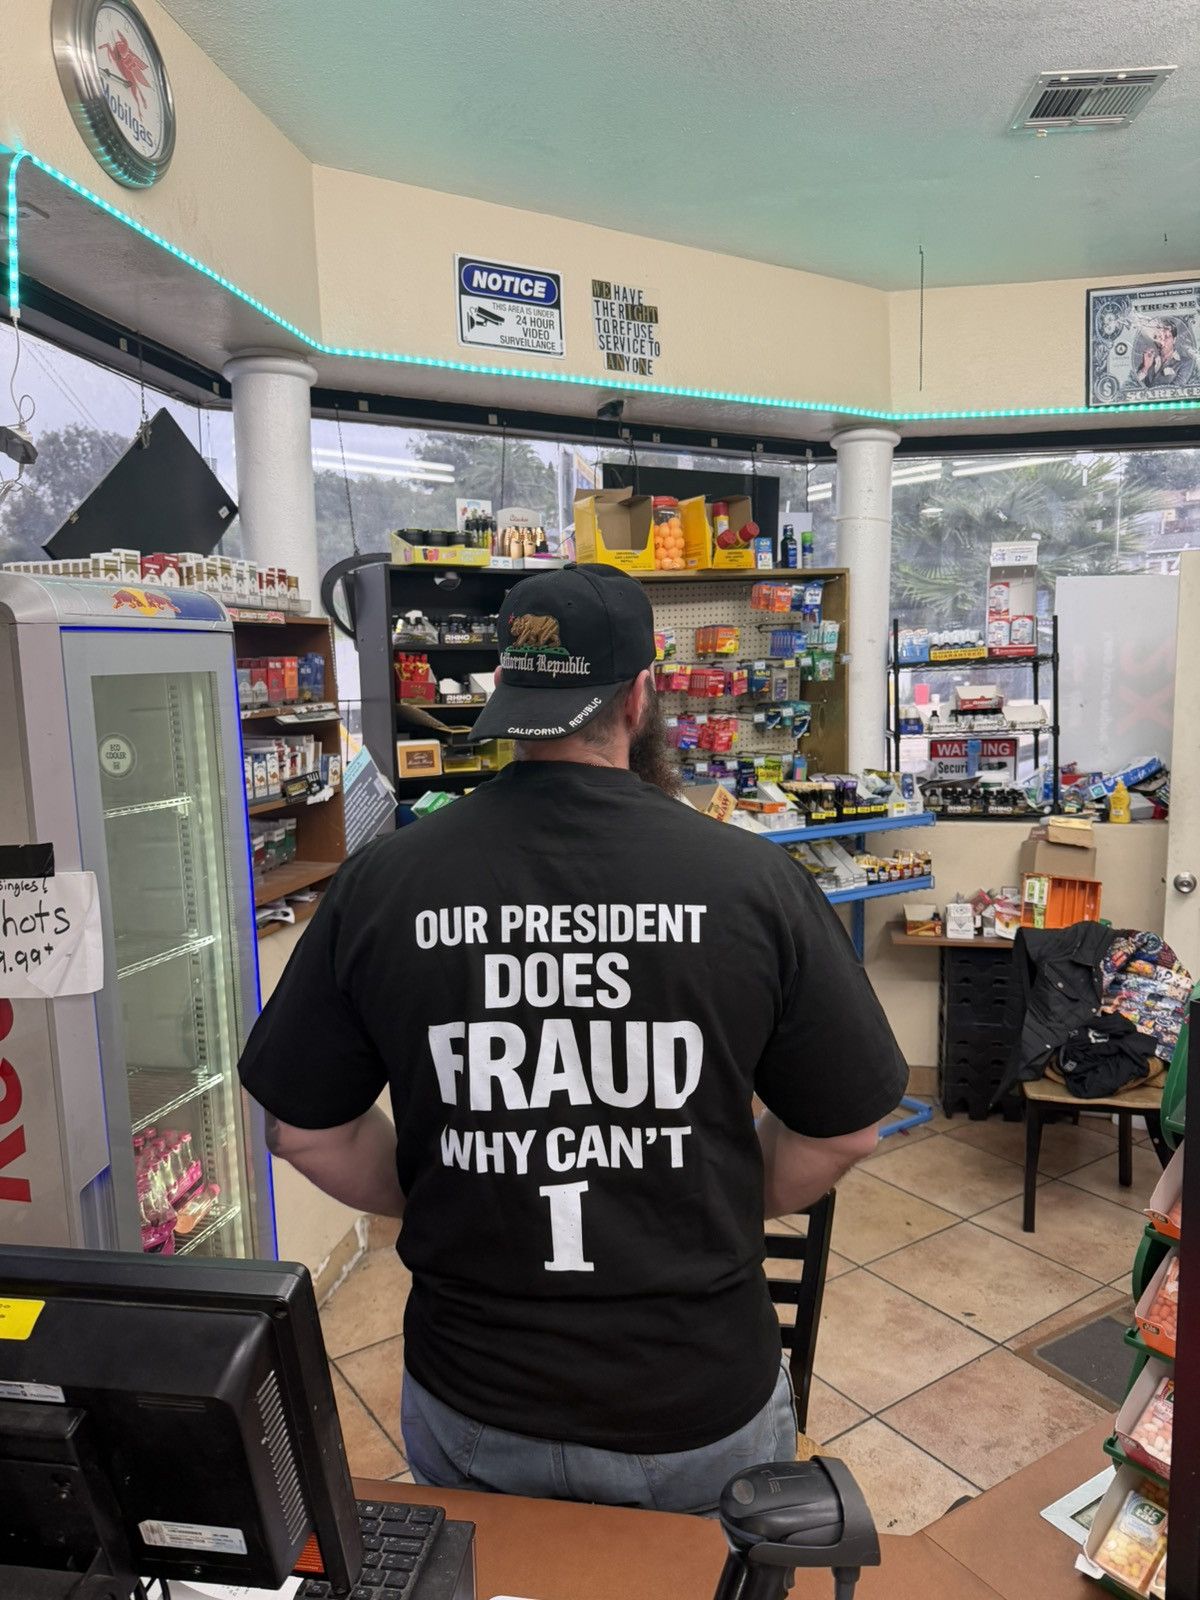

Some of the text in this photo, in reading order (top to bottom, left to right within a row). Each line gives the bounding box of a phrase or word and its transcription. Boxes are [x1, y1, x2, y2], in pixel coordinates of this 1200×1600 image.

[472, 270, 547, 298] NOTICE
[592, 279, 644, 306] WE HAVE
[493, 302, 555, 319] THIS AREA IS UNDER
[594, 299, 659, 324] THE RIGHT
[1141, 302, 1178, 312] TRUST
[1179, 300, 1196, 309] ME
[515, 314, 555, 330] 24 HOUR
[522, 326, 550, 341] VIDEO
[595, 317, 654, 341] TO REFUSE
[500, 334, 556, 351] SURVEILLANCE
[598, 334, 661, 358] SERVICE TO
[606, 352, 654, 376] ANYONE
[1126, 387, 1200, 401] SCARFACE
[537, 654, 591, 678] Republic
[568, 697, 602, 728] REPUBLIC
[507, 726, 566, 736] CALIFORNIA
[936, 743, 1011, 756] WARING
[2, 898, 70, 937] hots
[415, 904, 707, 949] OUR PRESIDENT
[484, 952, 632, 1009] DOES
[428, 1018, 704, 1112] FRAUD
[440, 1124, 692, 1175] WHY CAN'T
[539, 1180, 595, 1272] I
